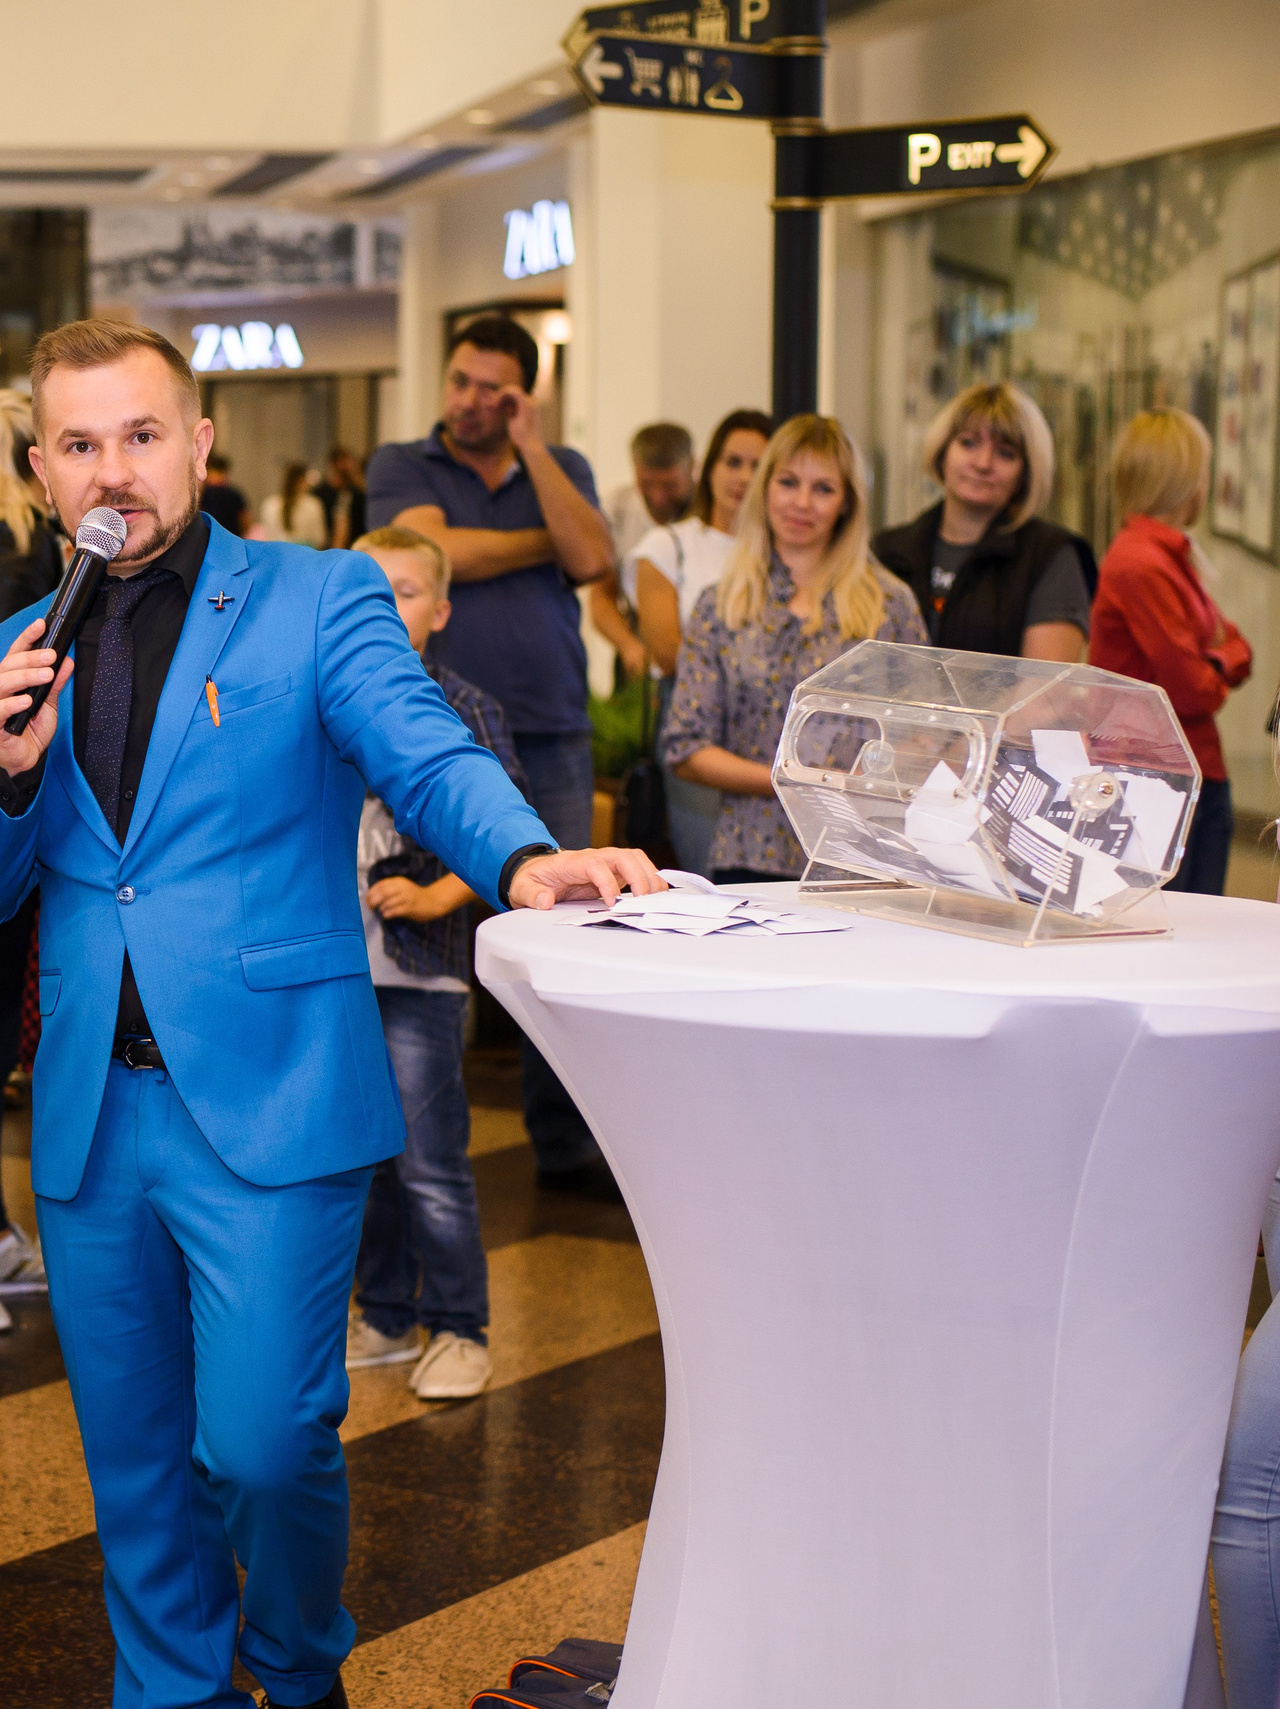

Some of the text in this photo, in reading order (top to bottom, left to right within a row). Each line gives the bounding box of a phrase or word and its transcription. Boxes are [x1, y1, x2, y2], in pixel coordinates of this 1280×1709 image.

[908, 132, 996, 186] P EXIT
[191, 320, 304, 372] ZARA
